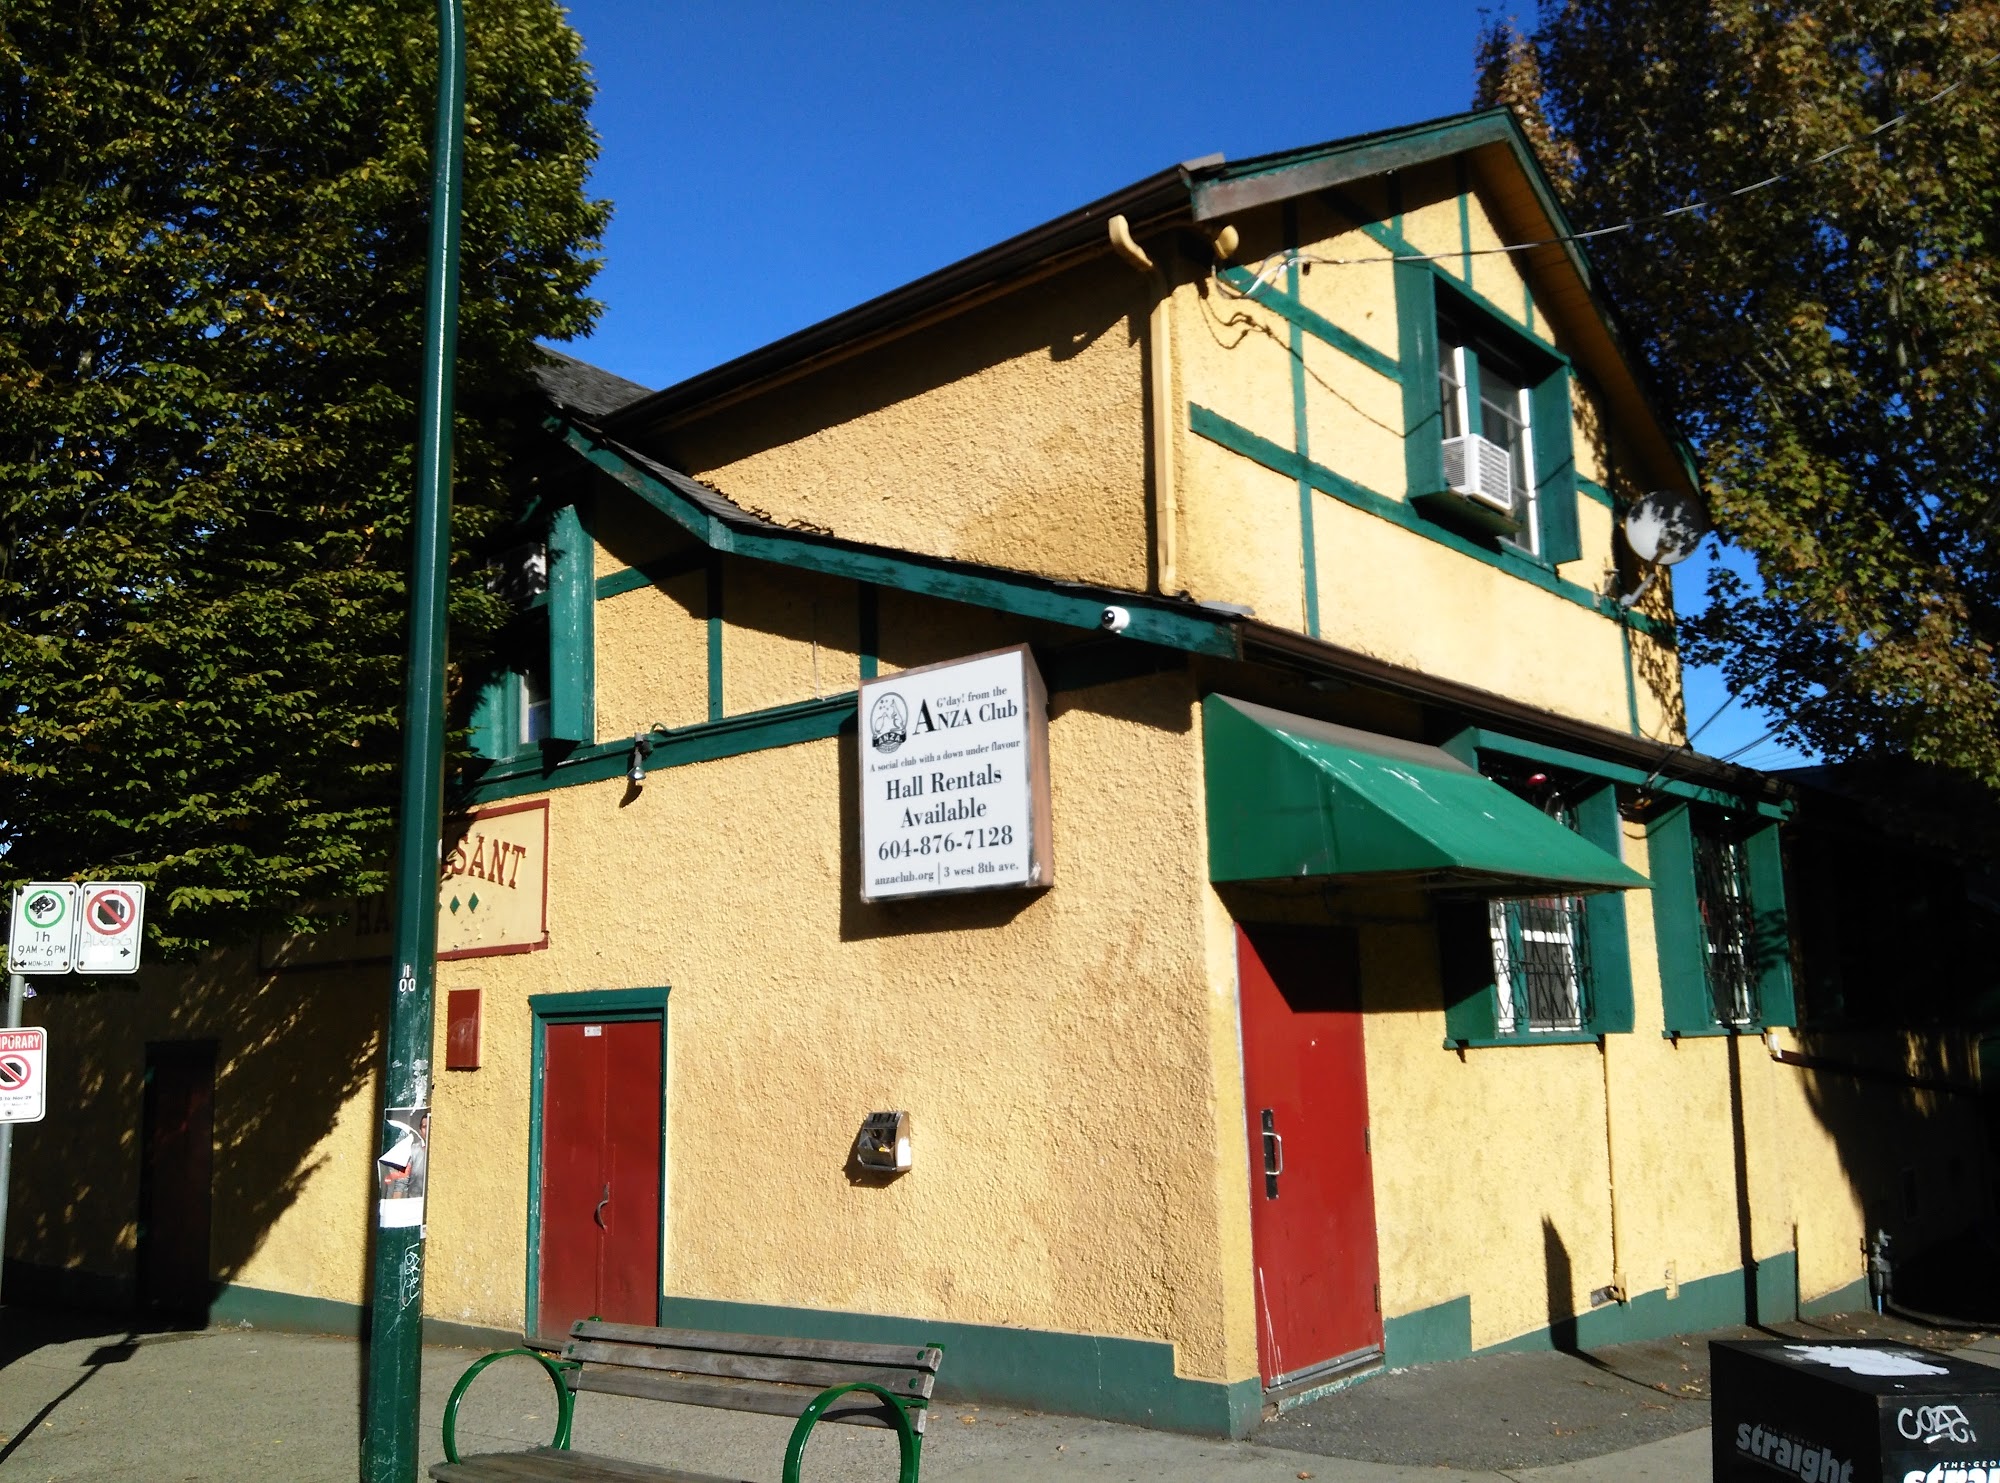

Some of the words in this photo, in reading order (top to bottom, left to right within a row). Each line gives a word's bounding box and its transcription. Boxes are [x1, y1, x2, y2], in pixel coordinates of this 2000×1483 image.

[967, 690, 990, 702] from
[992, 686, 1007, 697] the
[912, 698, 973, 736] ANZA
[979, 699, 1018, 723] Club
[878, 732, 902, 746] ANZA
[869, 763, 876, 773] A
[877, 759, 899, 771] social
[900, 756, 917, 767] club
[919, 752, 935, 763] with
[936, 753, 942, 761] a
[942, 749, 963, 760] down
[965, 744, 989, 756] under
[991, 740, 1021, 752] flavour
[886, 775, 923, 801] Hall
[931, 763, 1003, 793] Rentals
[901, 797, 988, 828] Available
[878, 824, 1014, 861] 604-876-7128
[446, 832, 527, 890] SANT
[875, 871, 935, 886] anzaclub.org
[943, 866, 951, 878] 3
[953, 866, 975, 877] west
[977, 861, 995, 875] 8th
[998, 862, 1020, 872] ave.
[17, 945, 38, 957] 9AM
[46, 945, 66, 957] 6PM
[0, 1034, 41, 1050] PORARY
